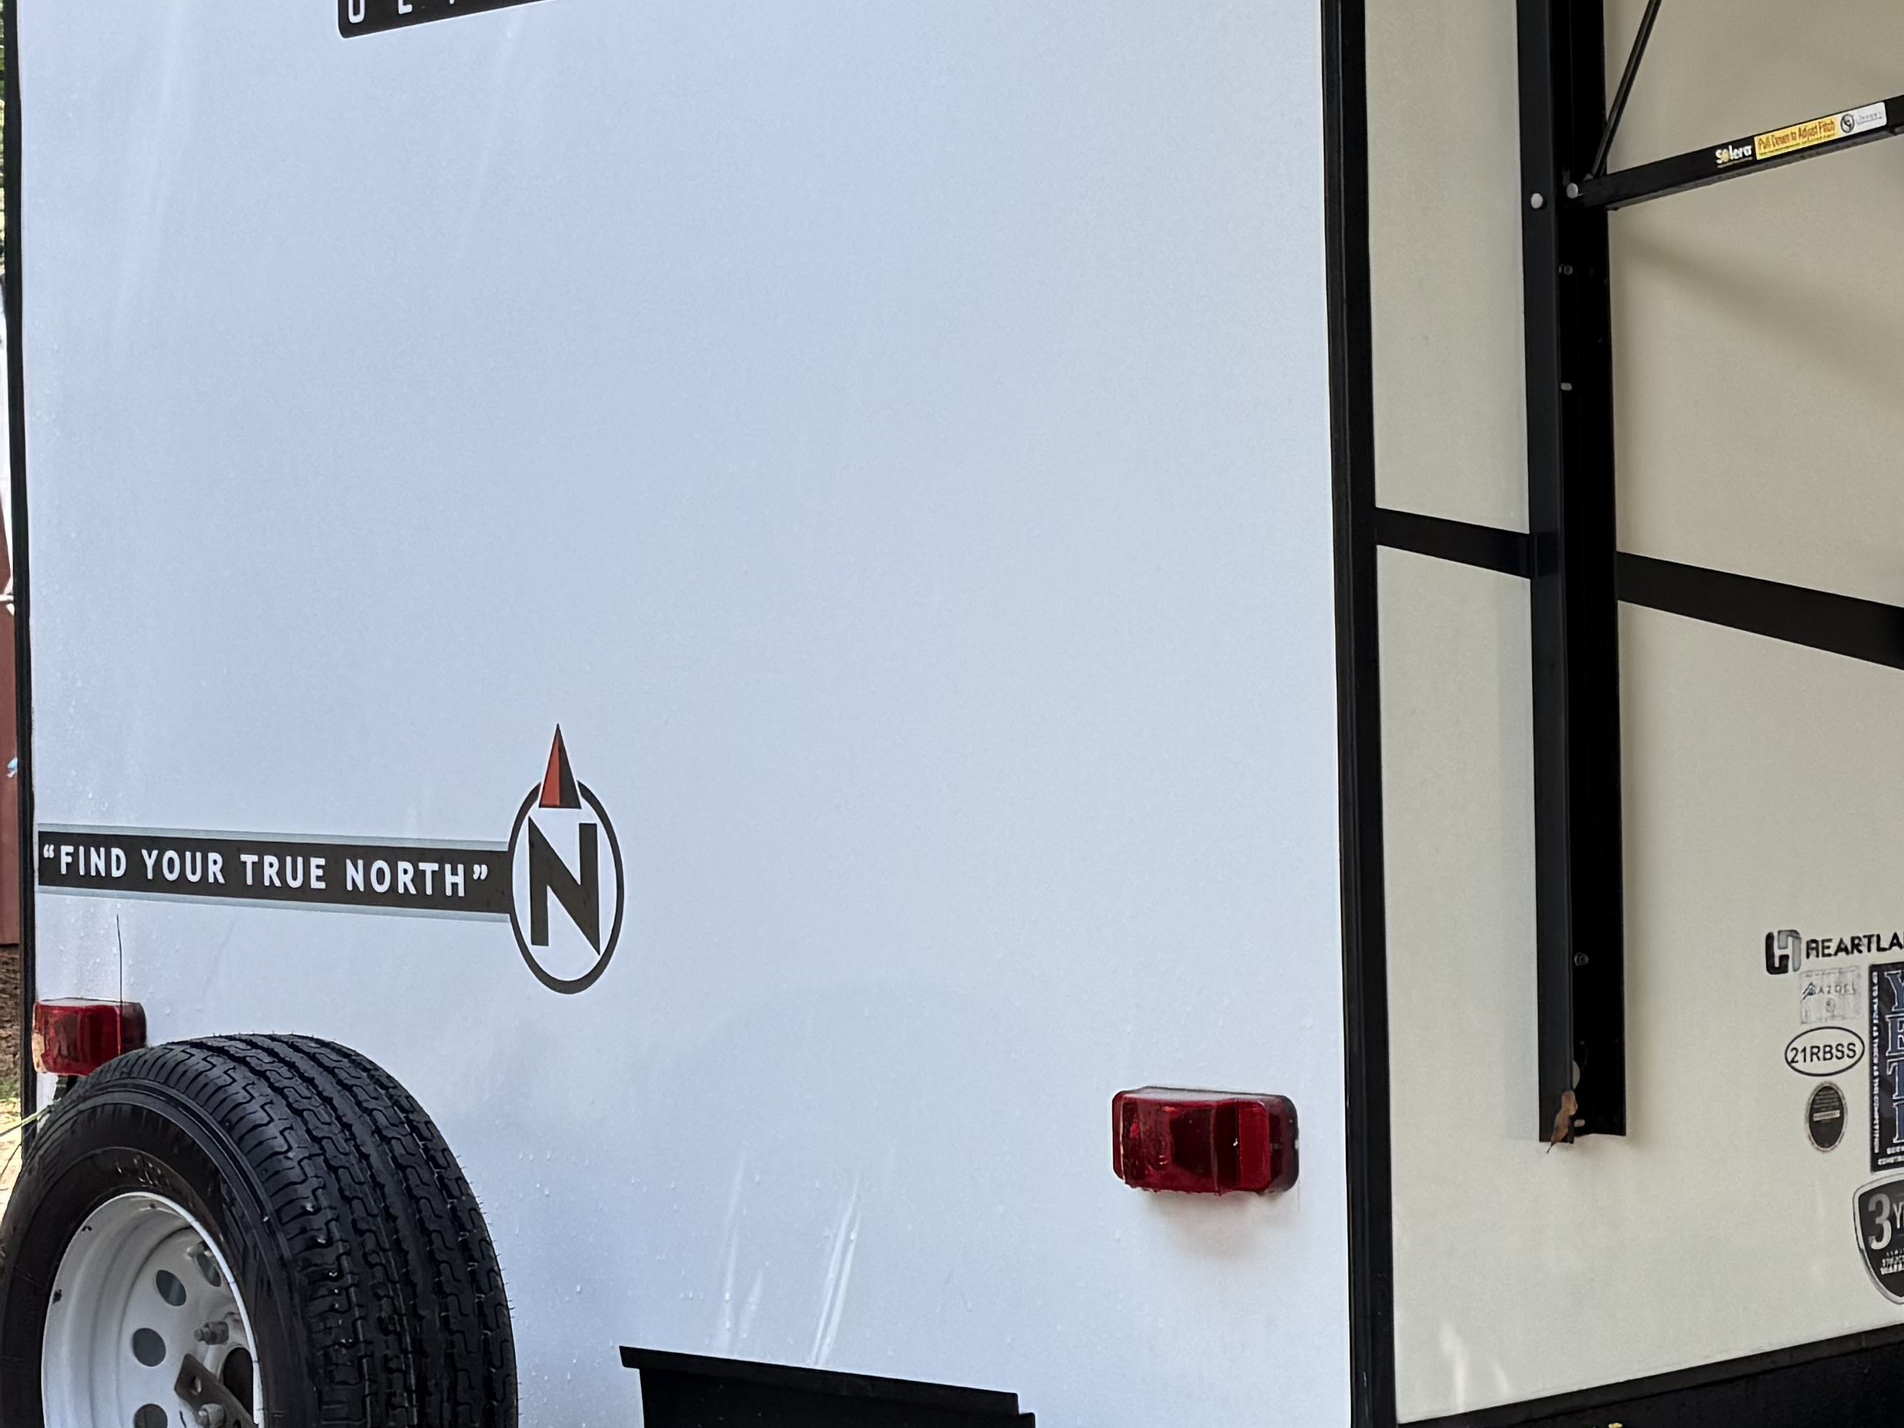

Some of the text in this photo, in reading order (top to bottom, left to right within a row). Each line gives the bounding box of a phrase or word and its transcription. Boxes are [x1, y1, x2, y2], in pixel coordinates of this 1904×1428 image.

[142, 848, 226, 885] YOUR
[240, 853, 327, 890] TRUE
[1789, 1042, 1858, 1064] 21RBSS
[1868, 1193, 1892, 1250] 3
